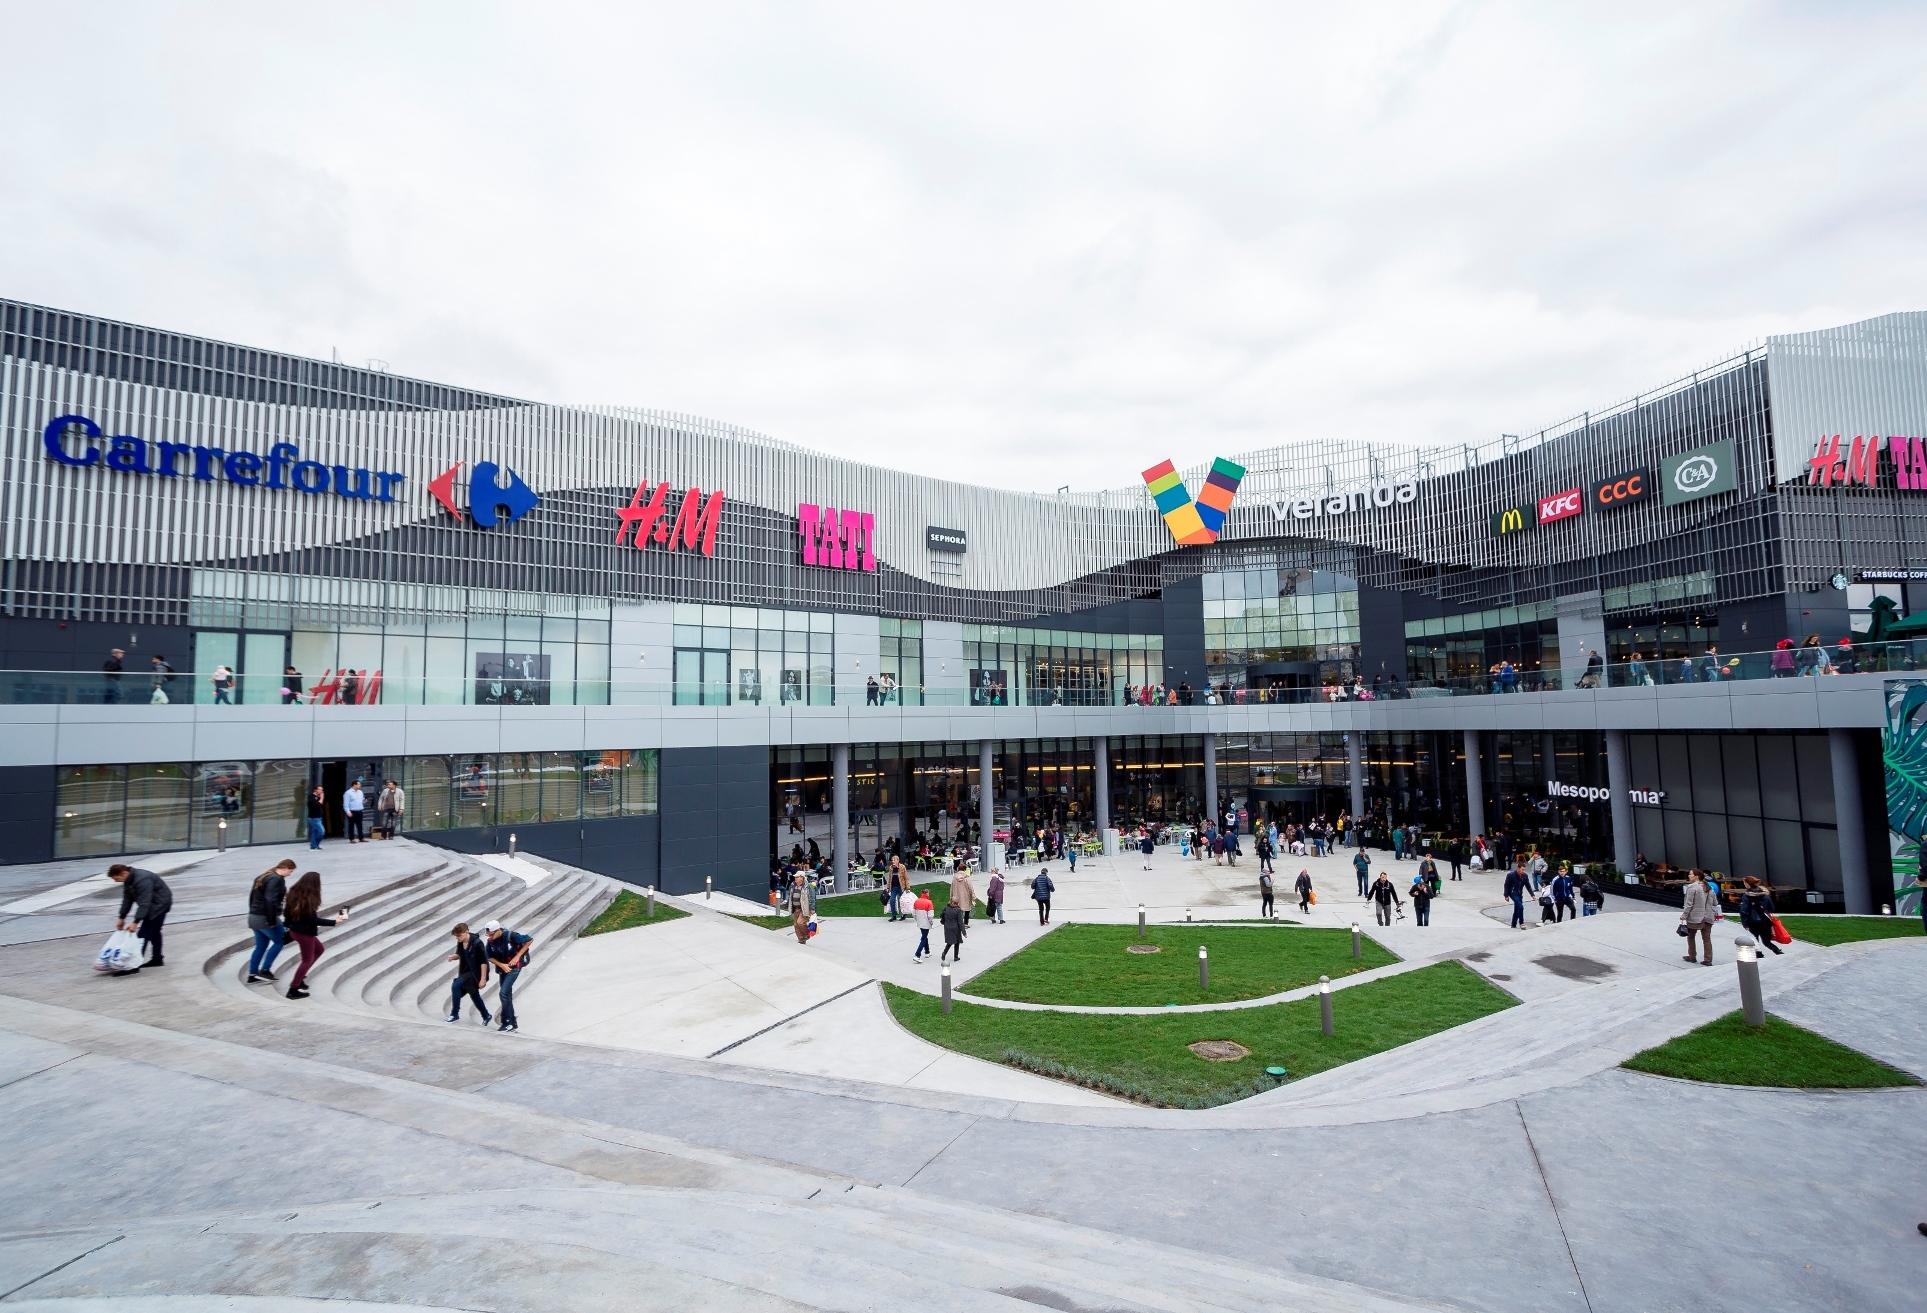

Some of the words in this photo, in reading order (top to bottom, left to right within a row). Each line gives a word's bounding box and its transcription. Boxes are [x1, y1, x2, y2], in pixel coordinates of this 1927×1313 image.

[44, 415, 404, 502] Carrefour
[1682, 464, 1710, 485] C&A
[1807, 434, 1879, 488] H&M
[1888, 437, 1927, 489] TA
[1271, 475, 1417, 521] veranda
[1540, 493, 1579, 519] KFC
[1599, 475, 1642, 504] CCC
[615, 480, 724, 558] H&M
[799, 503, 875, 571] TATI
[930, 533, 966, 545] SEPHORA
[1862, 570, 1908, 579] STARBUCKS
[308, 668, 382, 705] HM
